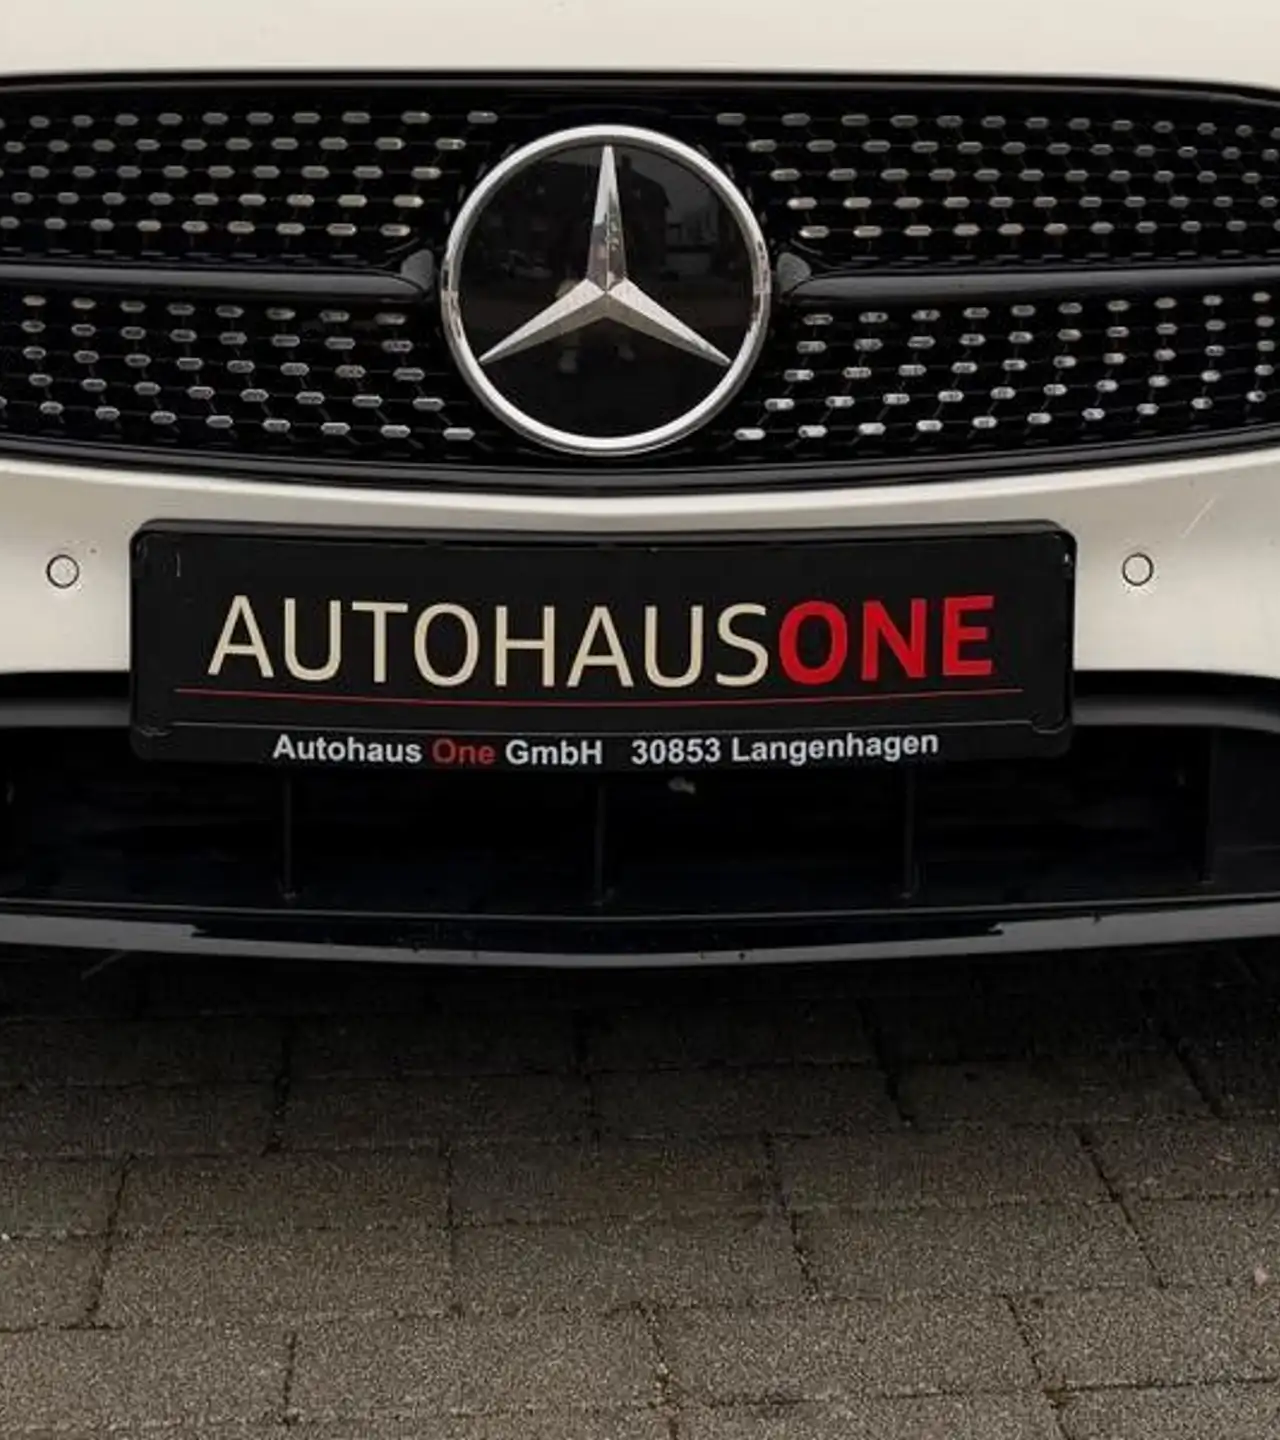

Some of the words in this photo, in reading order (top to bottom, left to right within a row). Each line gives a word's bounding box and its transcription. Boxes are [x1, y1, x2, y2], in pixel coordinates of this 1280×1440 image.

[207, 594, 995, 688] AUTOHAUSONE
[272, 733, 423, 764] Autohaus
[432, 738, 496, 765] One
[505, 738, 603, 766] GmbH
[631, 736, 721, 766] 30853
[731, 732, 939, 767] Langenhagen
